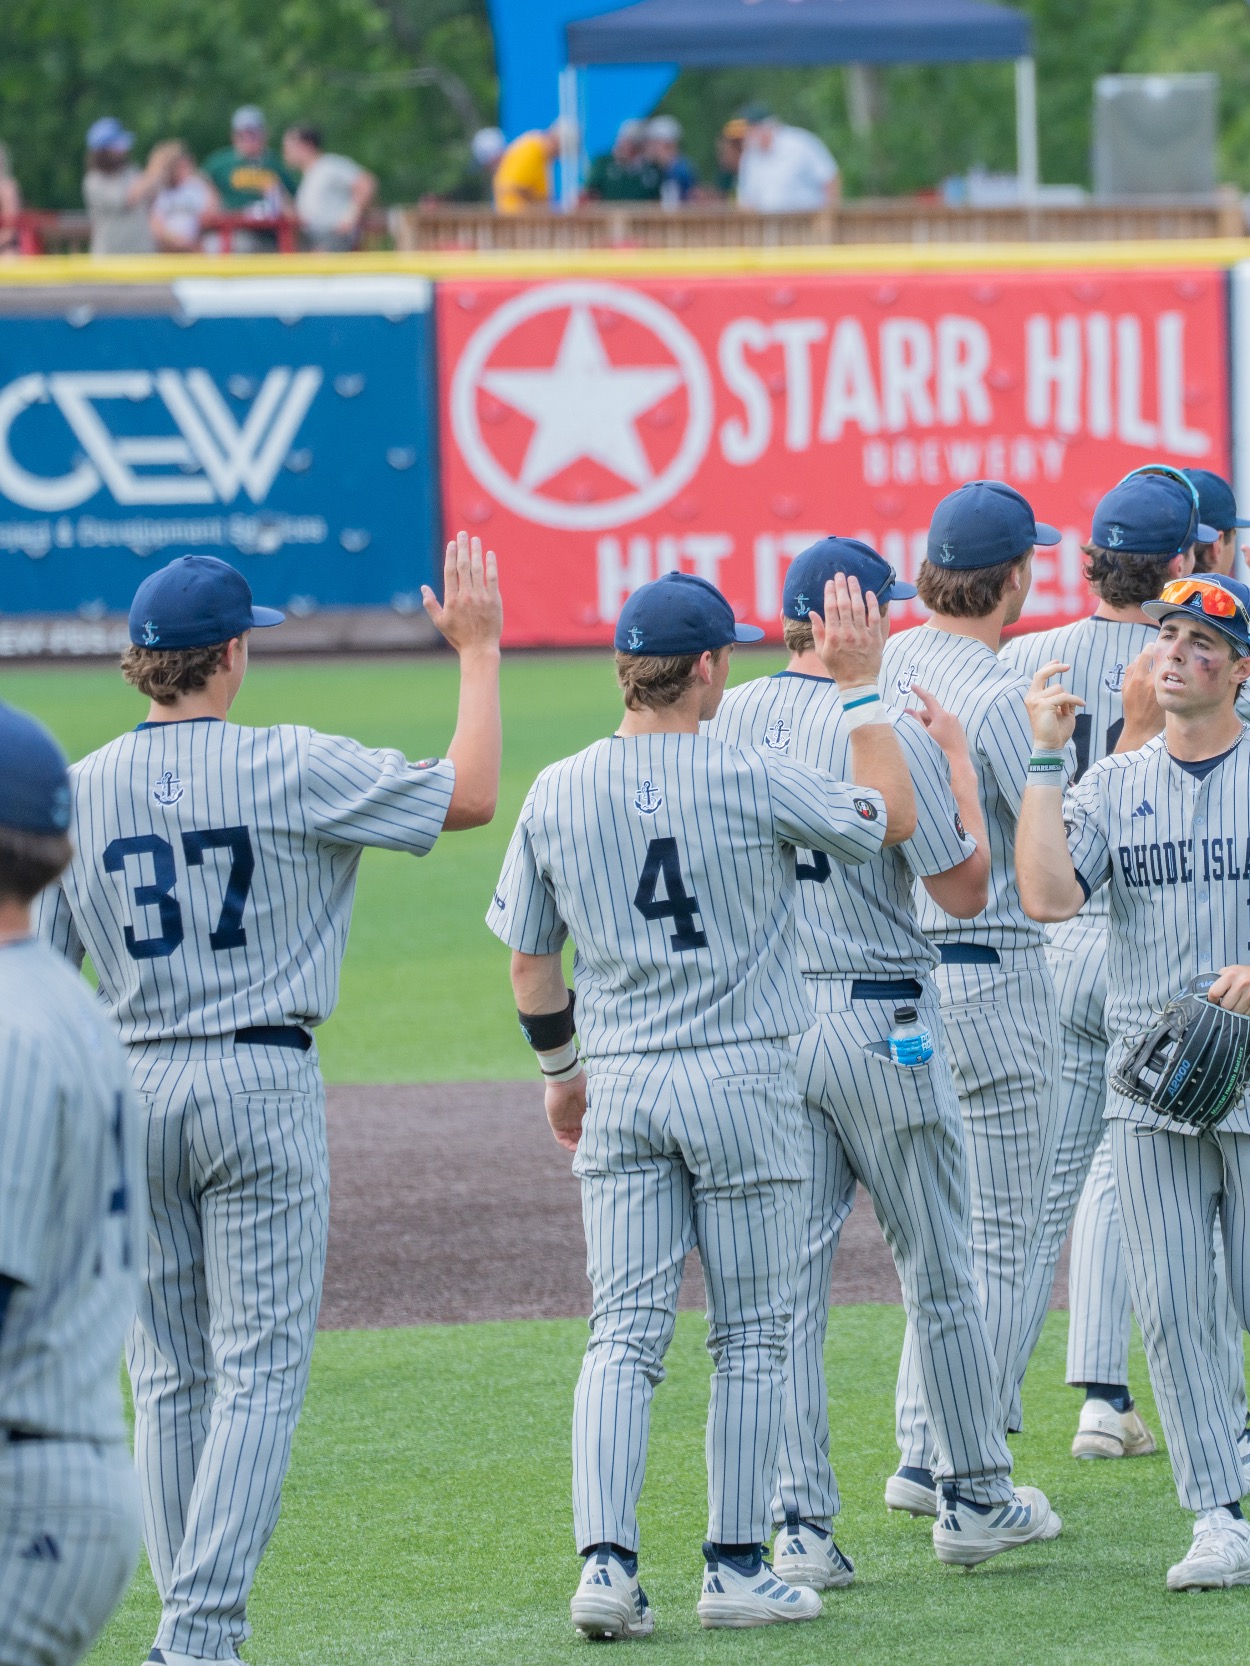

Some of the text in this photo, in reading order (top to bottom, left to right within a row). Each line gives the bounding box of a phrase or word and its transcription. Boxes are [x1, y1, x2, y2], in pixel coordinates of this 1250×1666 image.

[717, 311, 1212, 467] STARR HILL
[863, 435, 1067, 487] BREWERY
[102, 825, 255, 960] 37
[633, 836, 708, 952] 4
[1118, 839, 1193, 888] RHODE
[1167, 1059, 1191, 1097] A2000
[1211, 1046, 1244, 1116] Mental Health Matters
